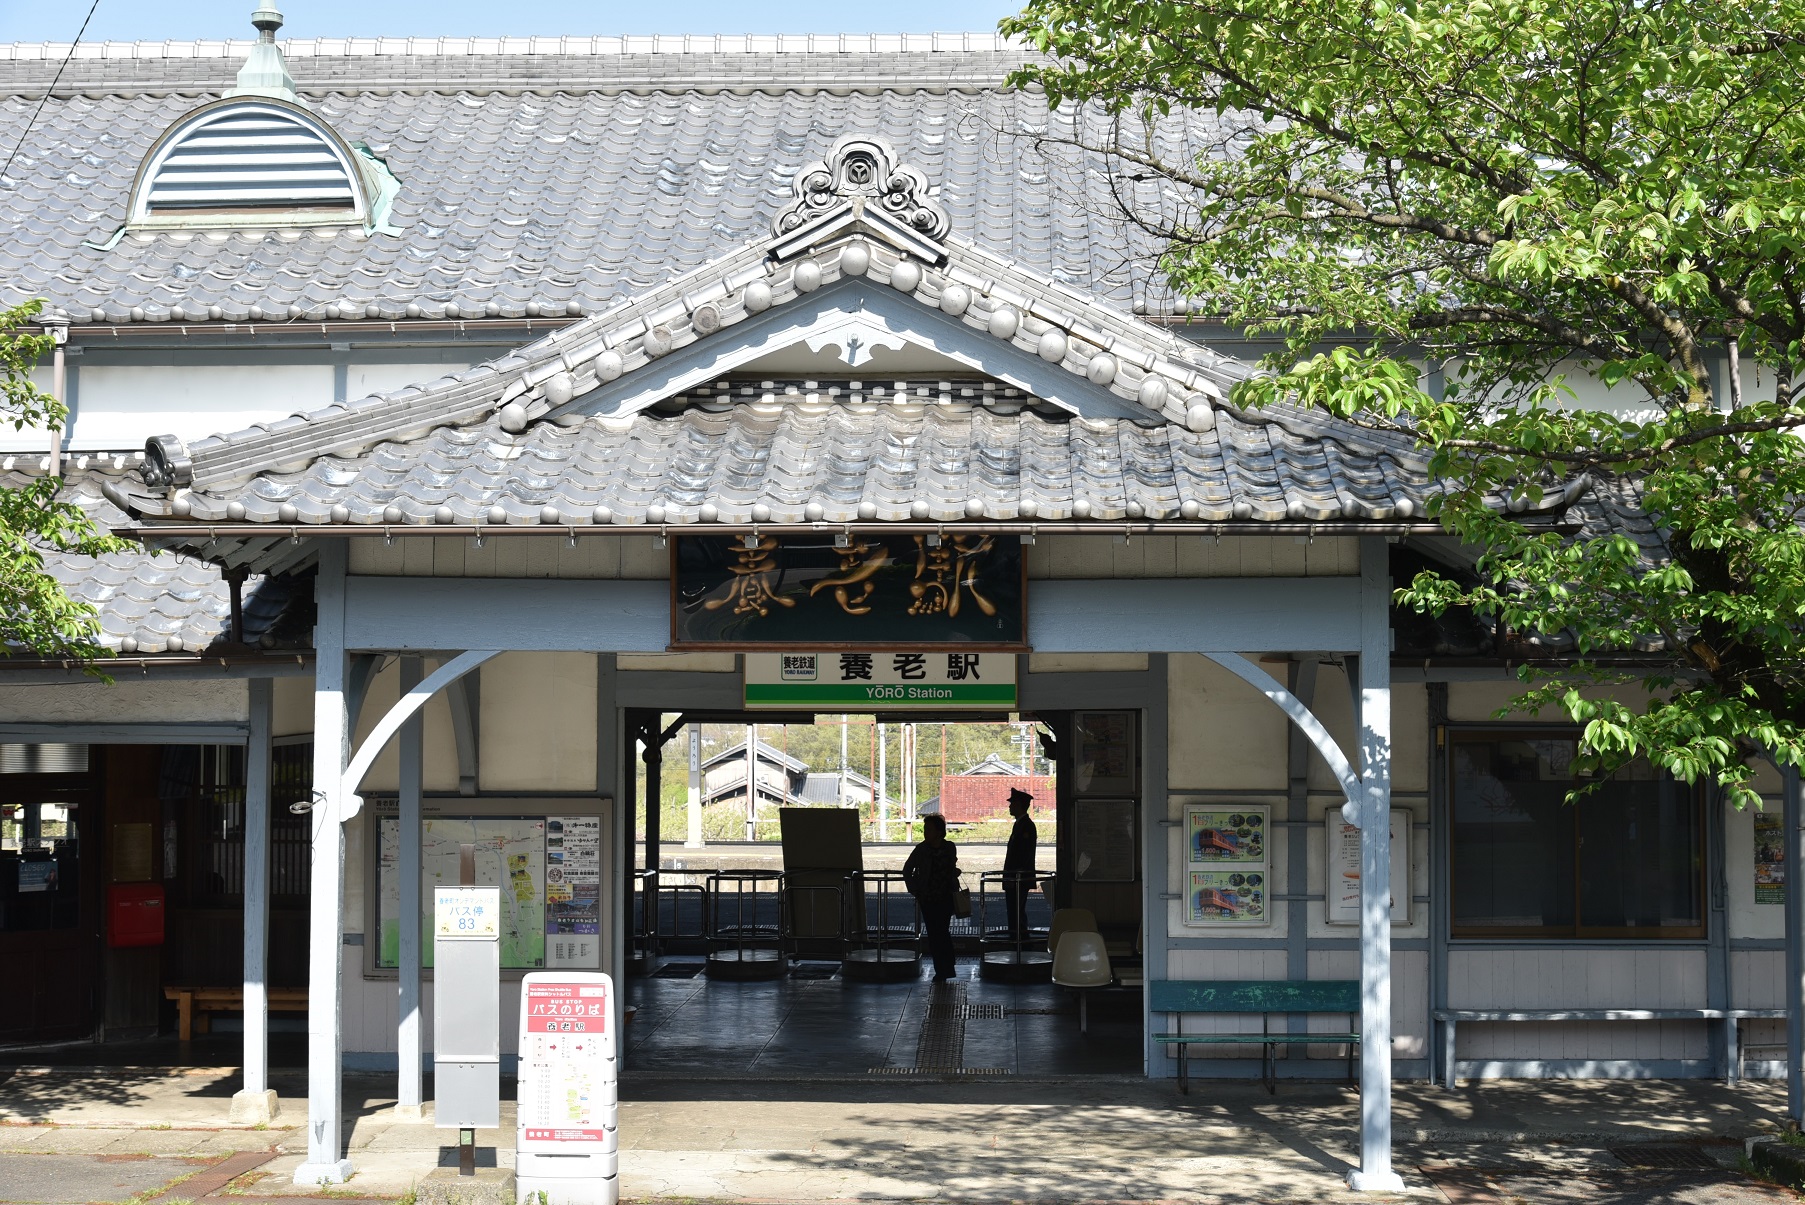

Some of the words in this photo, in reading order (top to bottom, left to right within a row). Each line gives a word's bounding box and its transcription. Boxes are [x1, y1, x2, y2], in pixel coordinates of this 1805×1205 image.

[784, 656, 816, 669] 養老鉄道
[840, 653, 980, 681] 養老駅
[866, 685, 905, 698] YŌRŌ
[908, 687, 952, 698] Station
[450, 906, 483, 916] バス停
[459, 918, 474, 929] 83
[533, 1004, 600, 1015] バスのりば
[547, 1022, 585, 1032] 養老駅
